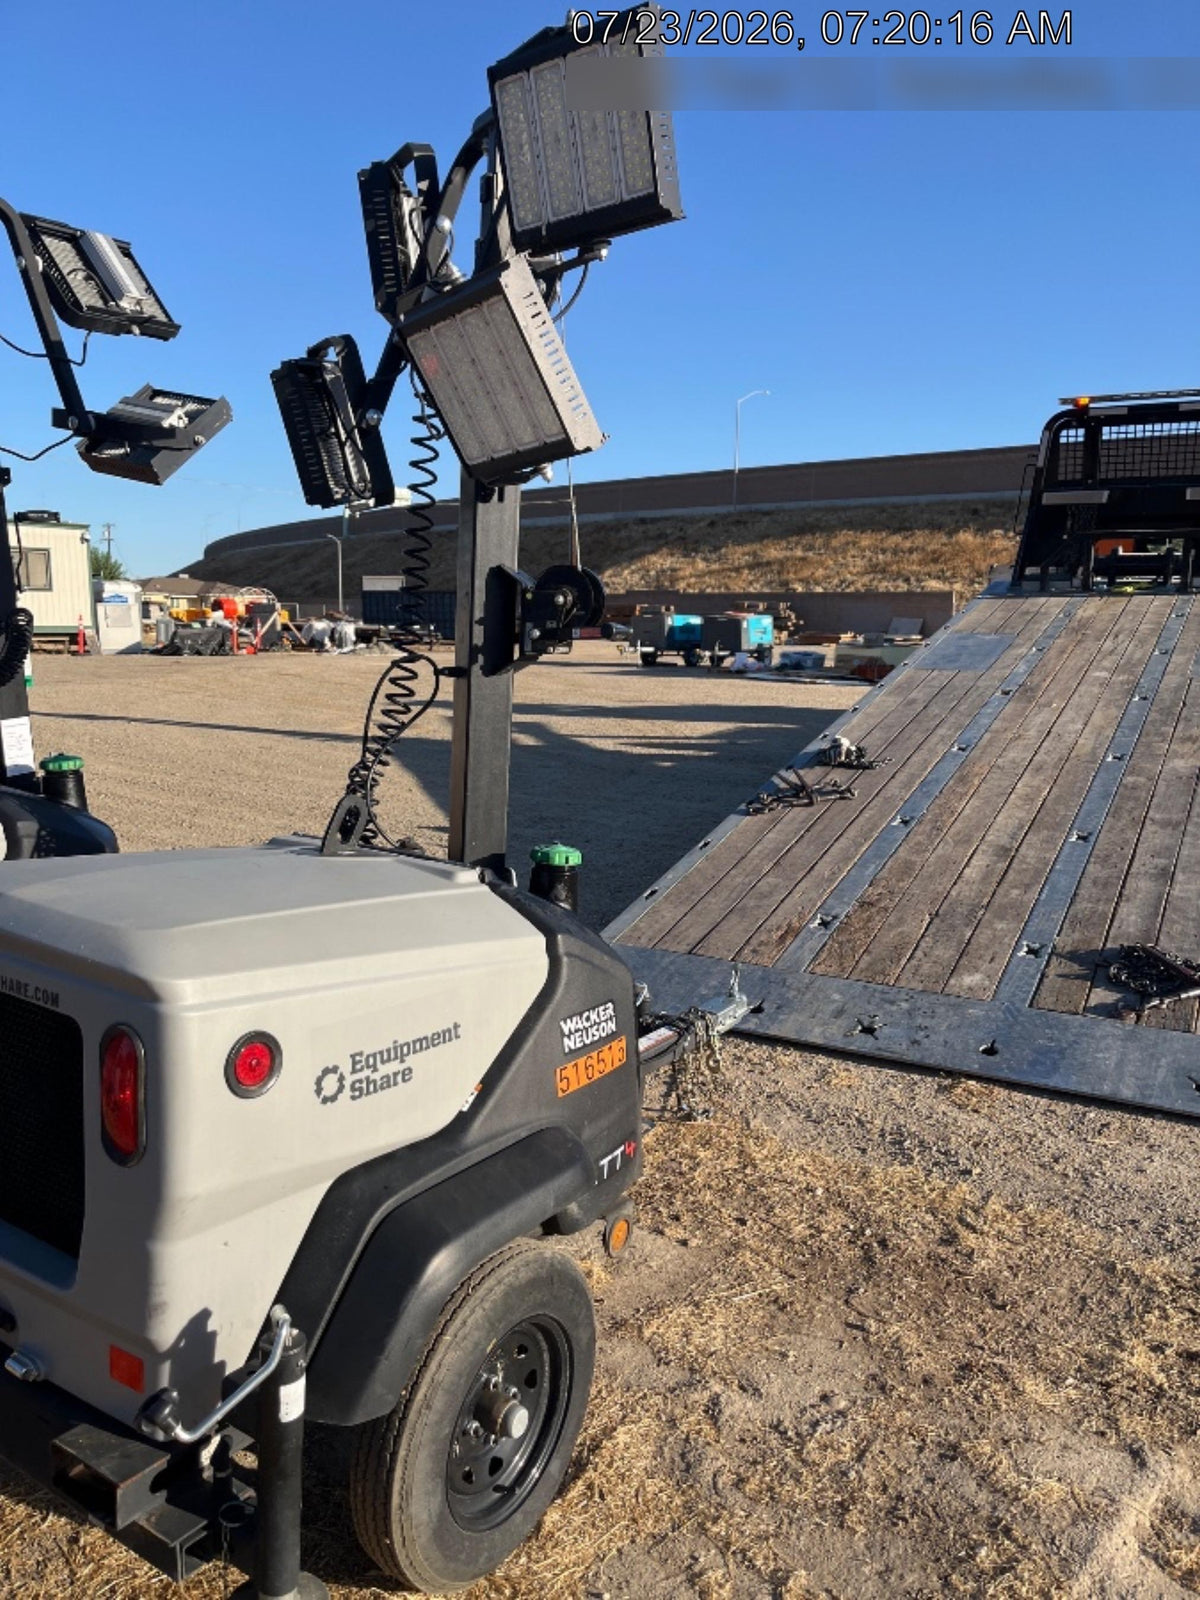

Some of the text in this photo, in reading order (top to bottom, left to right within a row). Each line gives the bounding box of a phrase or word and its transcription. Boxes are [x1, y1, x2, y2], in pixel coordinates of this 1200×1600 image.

[560, 1002, 616, 1035] WACKER
[563, 1016, 616, 1053] NEUSON
[350, 1021, 461, 1074] Equipment
[349, 1065, 413, 1101] Share
